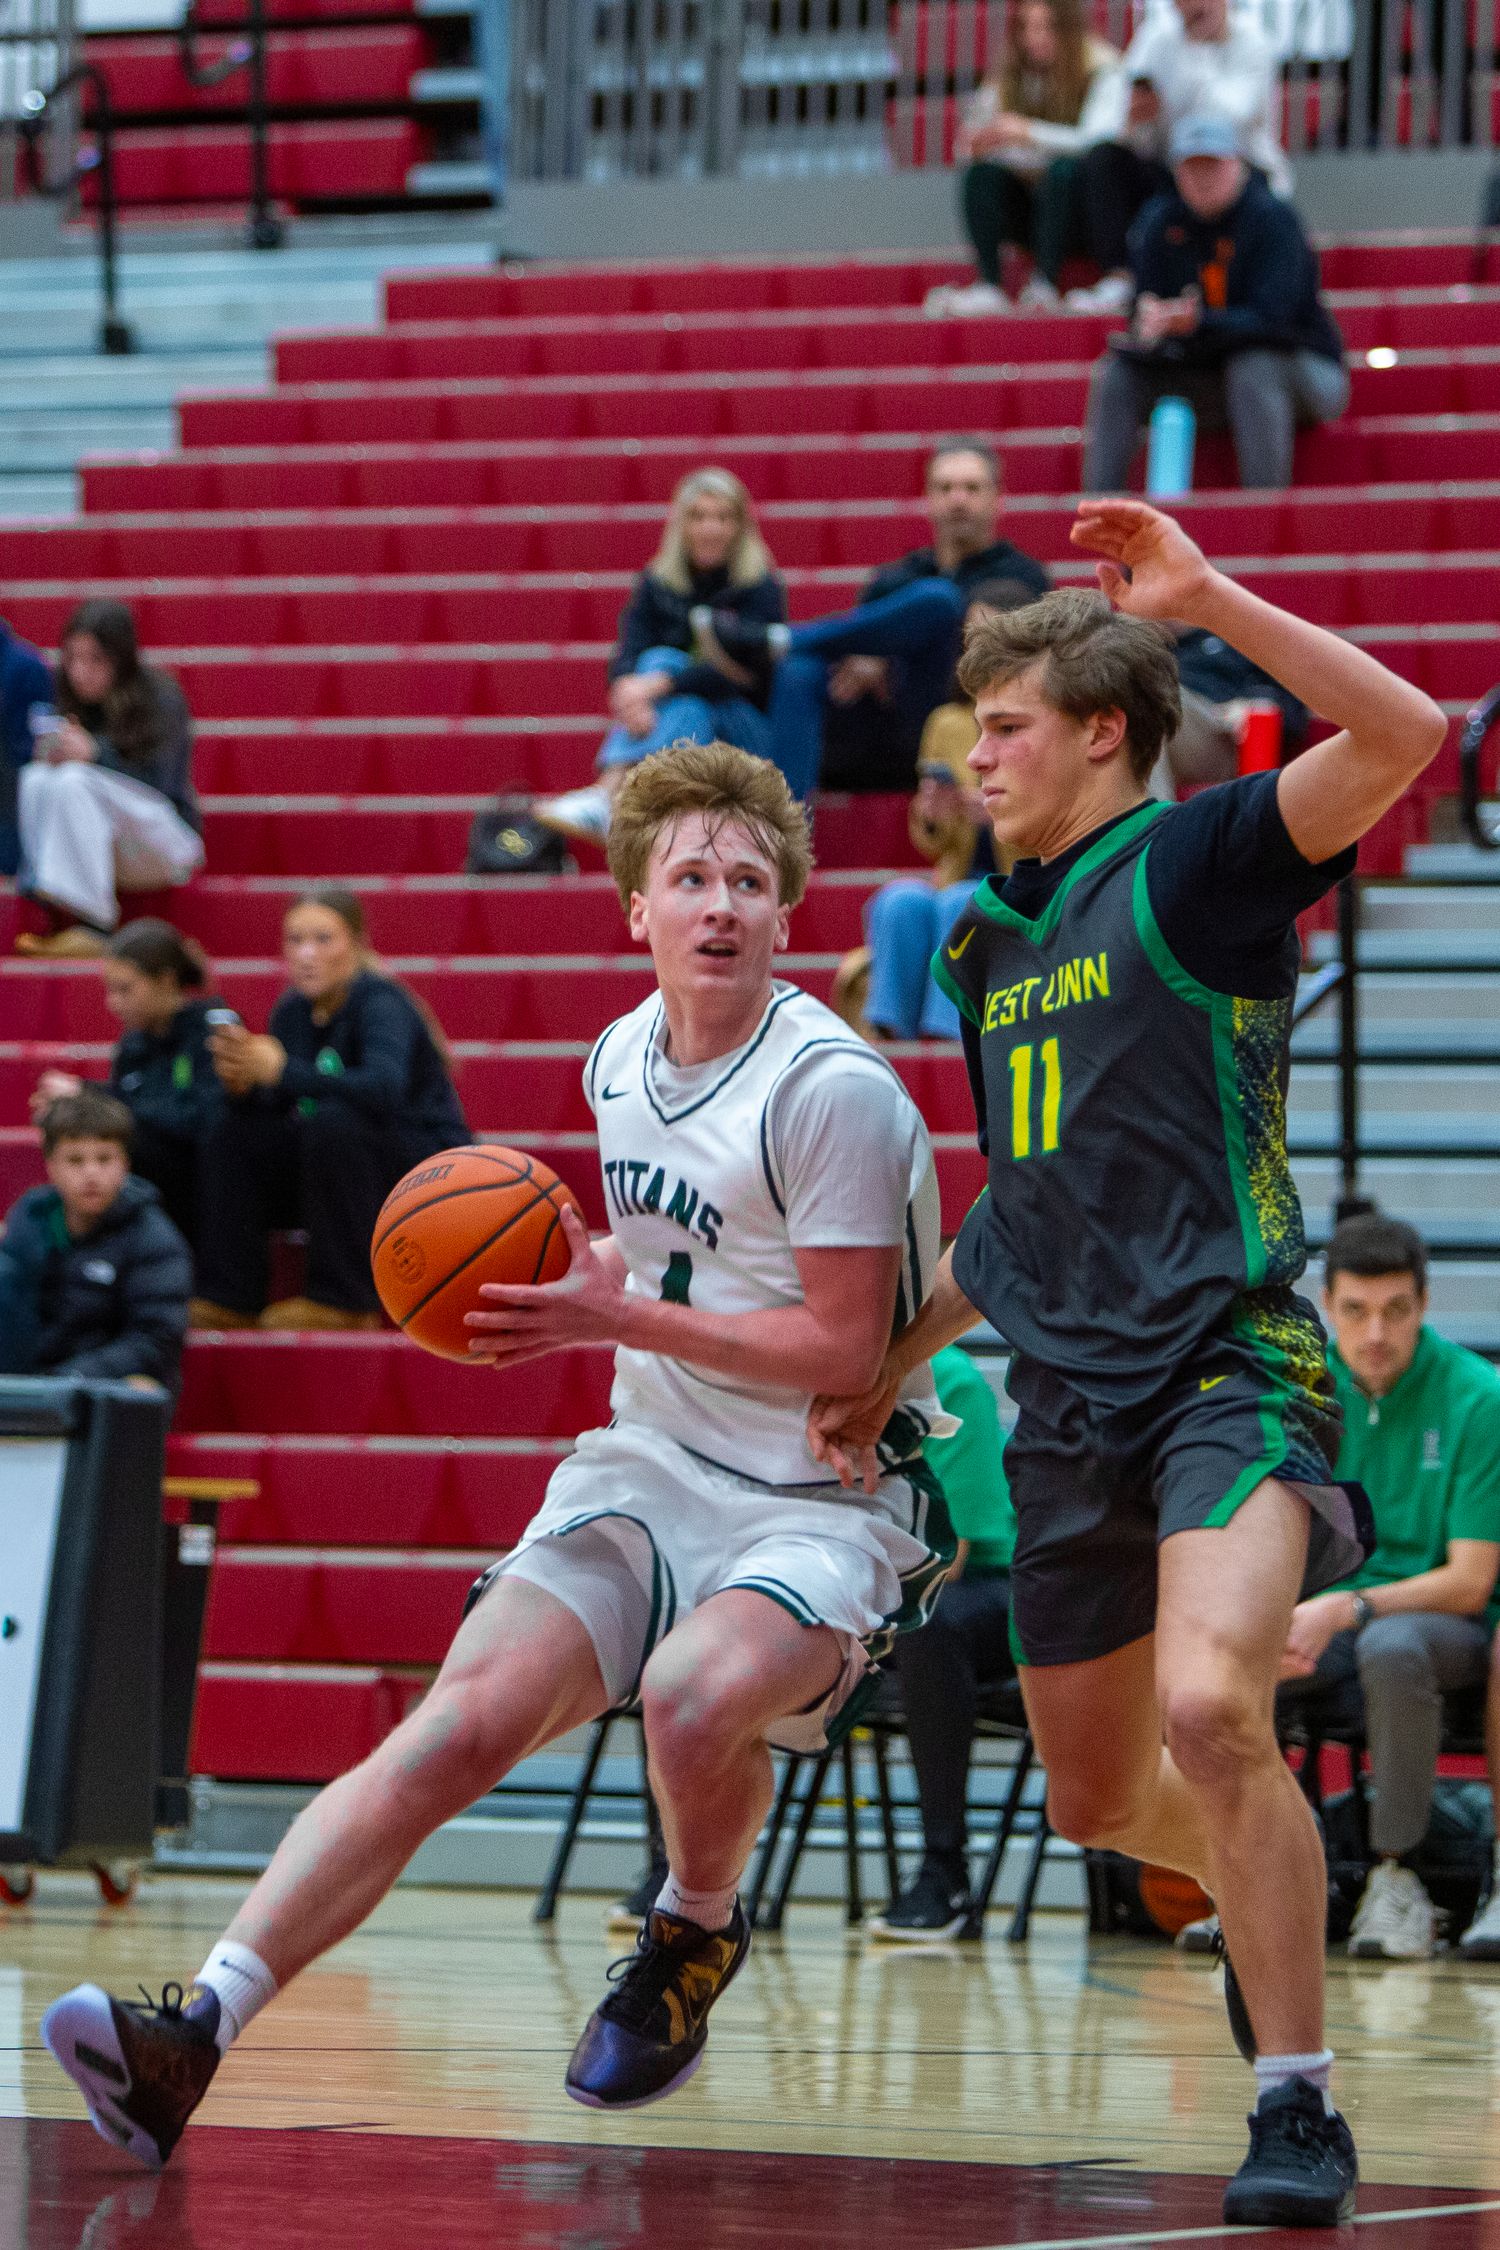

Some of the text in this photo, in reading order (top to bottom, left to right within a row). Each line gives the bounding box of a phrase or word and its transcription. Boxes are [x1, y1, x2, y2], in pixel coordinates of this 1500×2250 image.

[1041, 951, 1111, 1014] LINN
[1008, 1034, 1062, 1162] 11
[604, 1159, 724, 1252] TITANS
